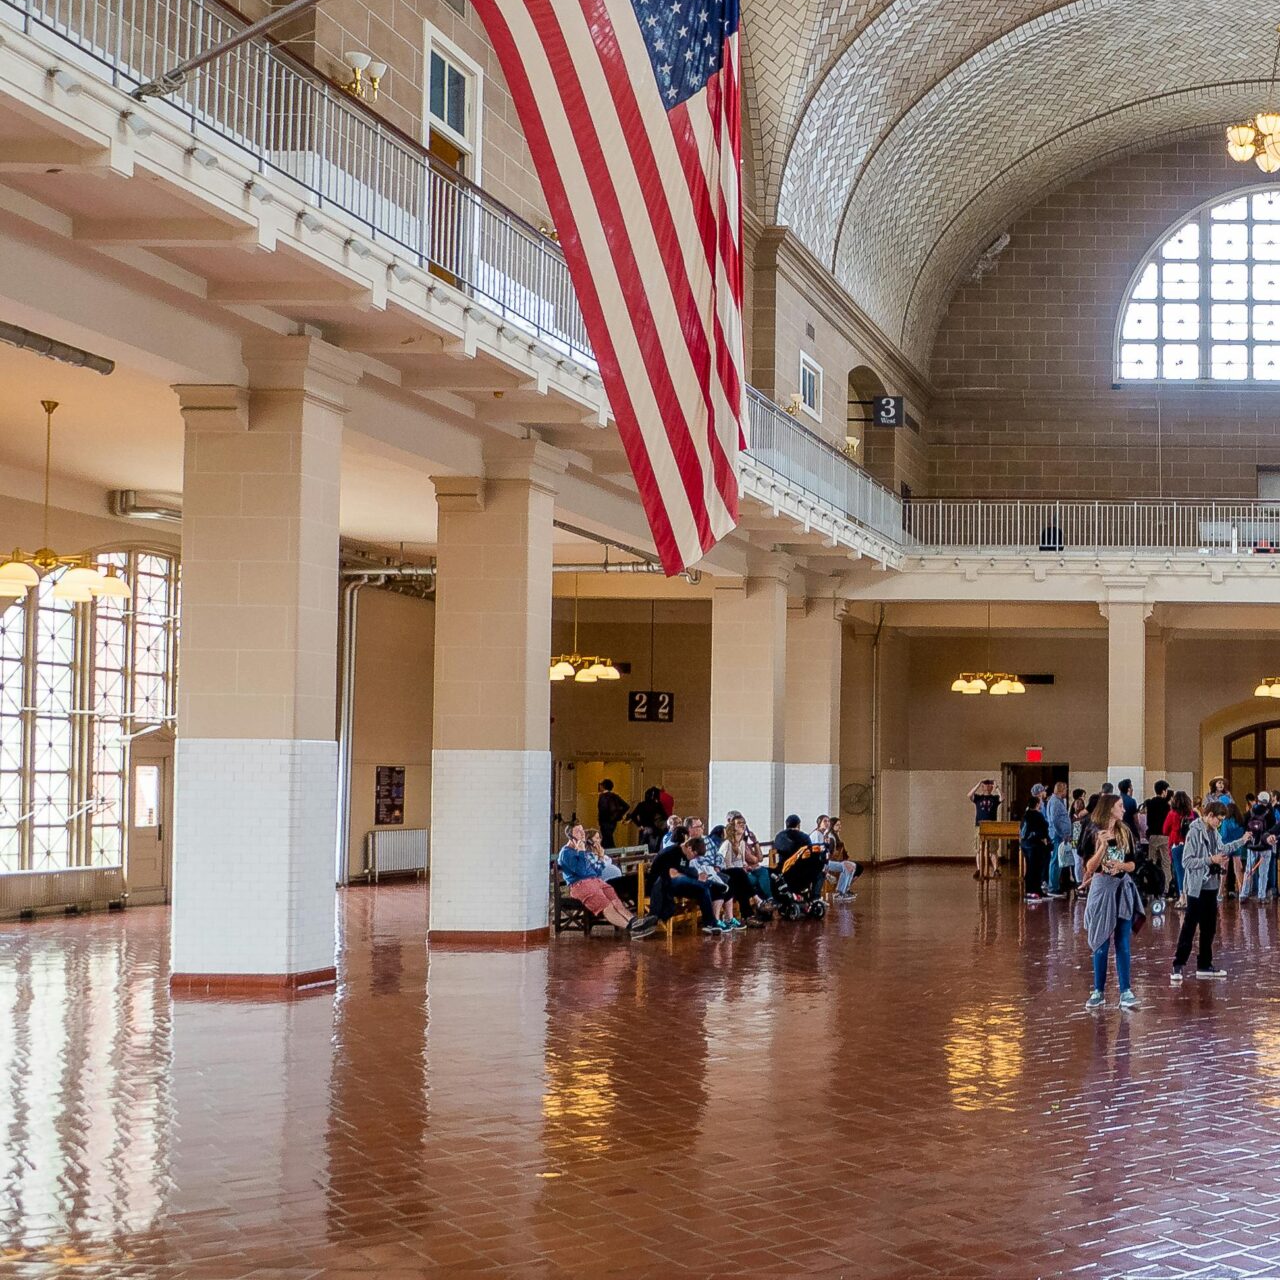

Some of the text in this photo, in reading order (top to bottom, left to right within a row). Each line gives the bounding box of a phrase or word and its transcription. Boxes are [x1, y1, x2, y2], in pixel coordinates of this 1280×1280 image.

[880, 397, 896, 418] 3
[634, 693, 648, 713] 2
[658, 694, 670, 713] 2
